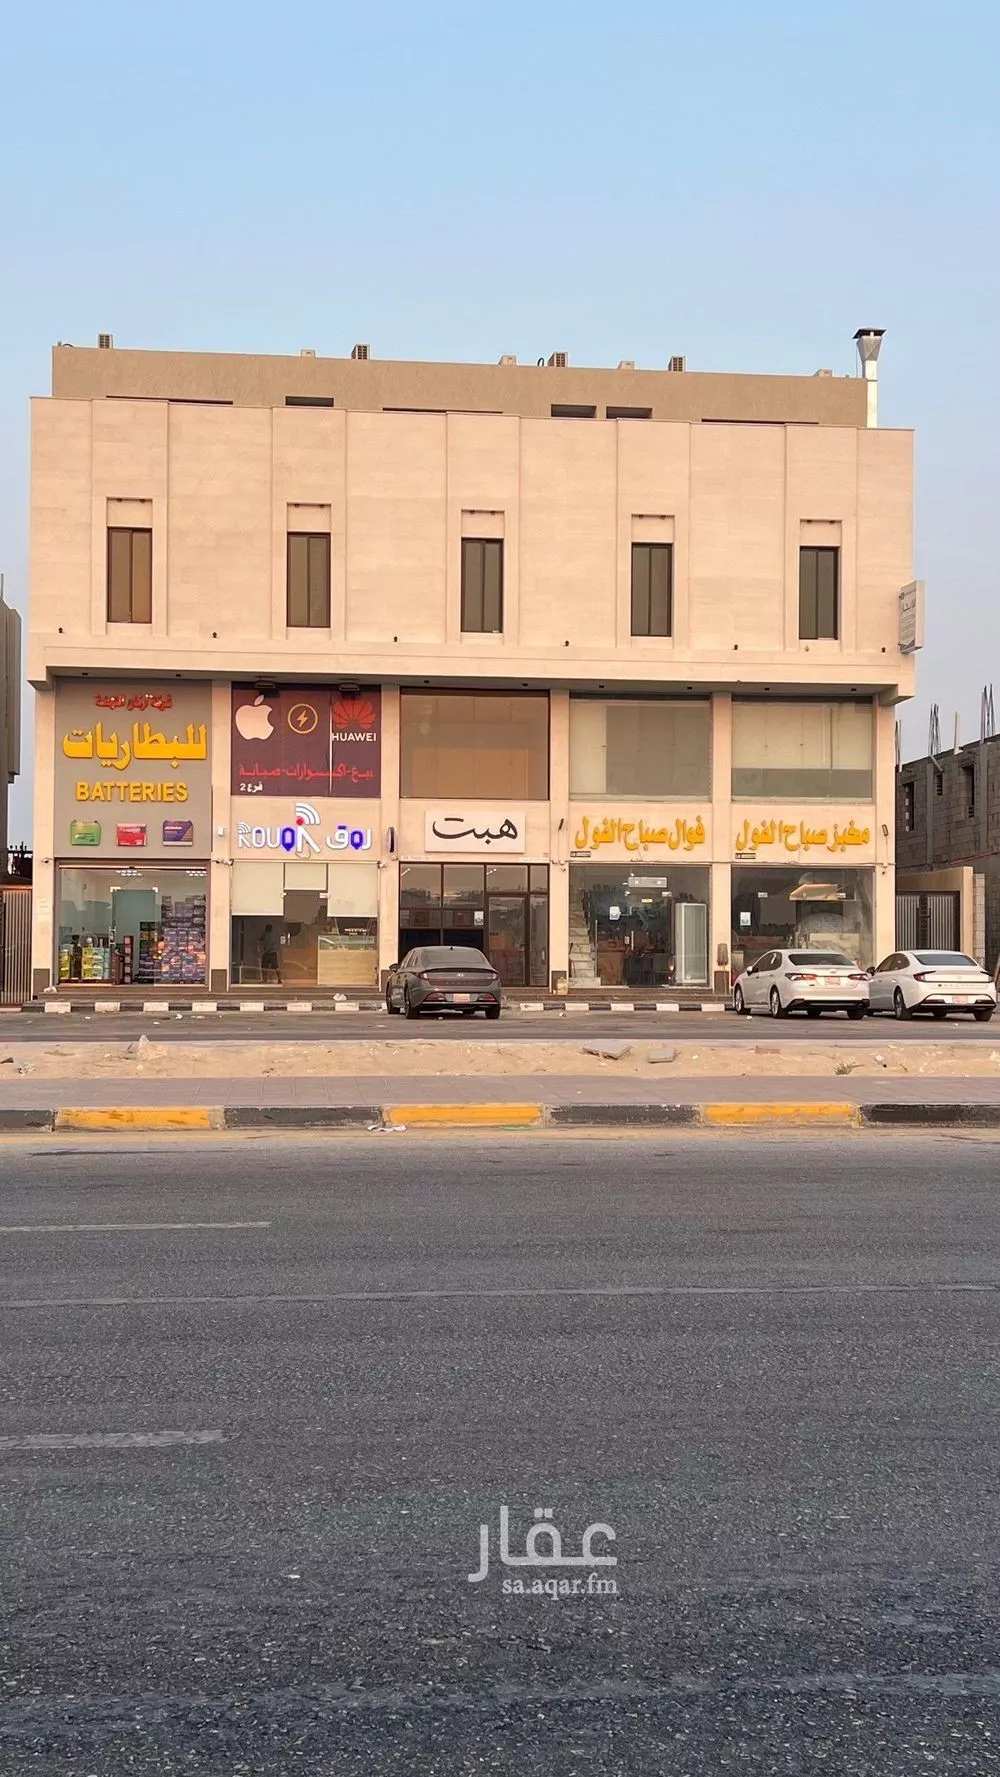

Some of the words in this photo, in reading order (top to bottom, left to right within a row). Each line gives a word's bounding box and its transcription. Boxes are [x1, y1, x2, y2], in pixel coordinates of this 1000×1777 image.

[62, 721, 207, 771] للبطاريات
[332, 732, 377, 742] HUAWEI
[75, 780, 189, 803] BATTERIES
[239, 782, 246, 791] 2
[247, 781, 263, 792] فرع
[575, 816, 621, 850] الفول
[668, 815, 706, 851] فوال
[735, 819, 783, 851] الفول
[827, 819, 870, 852] مخبز
